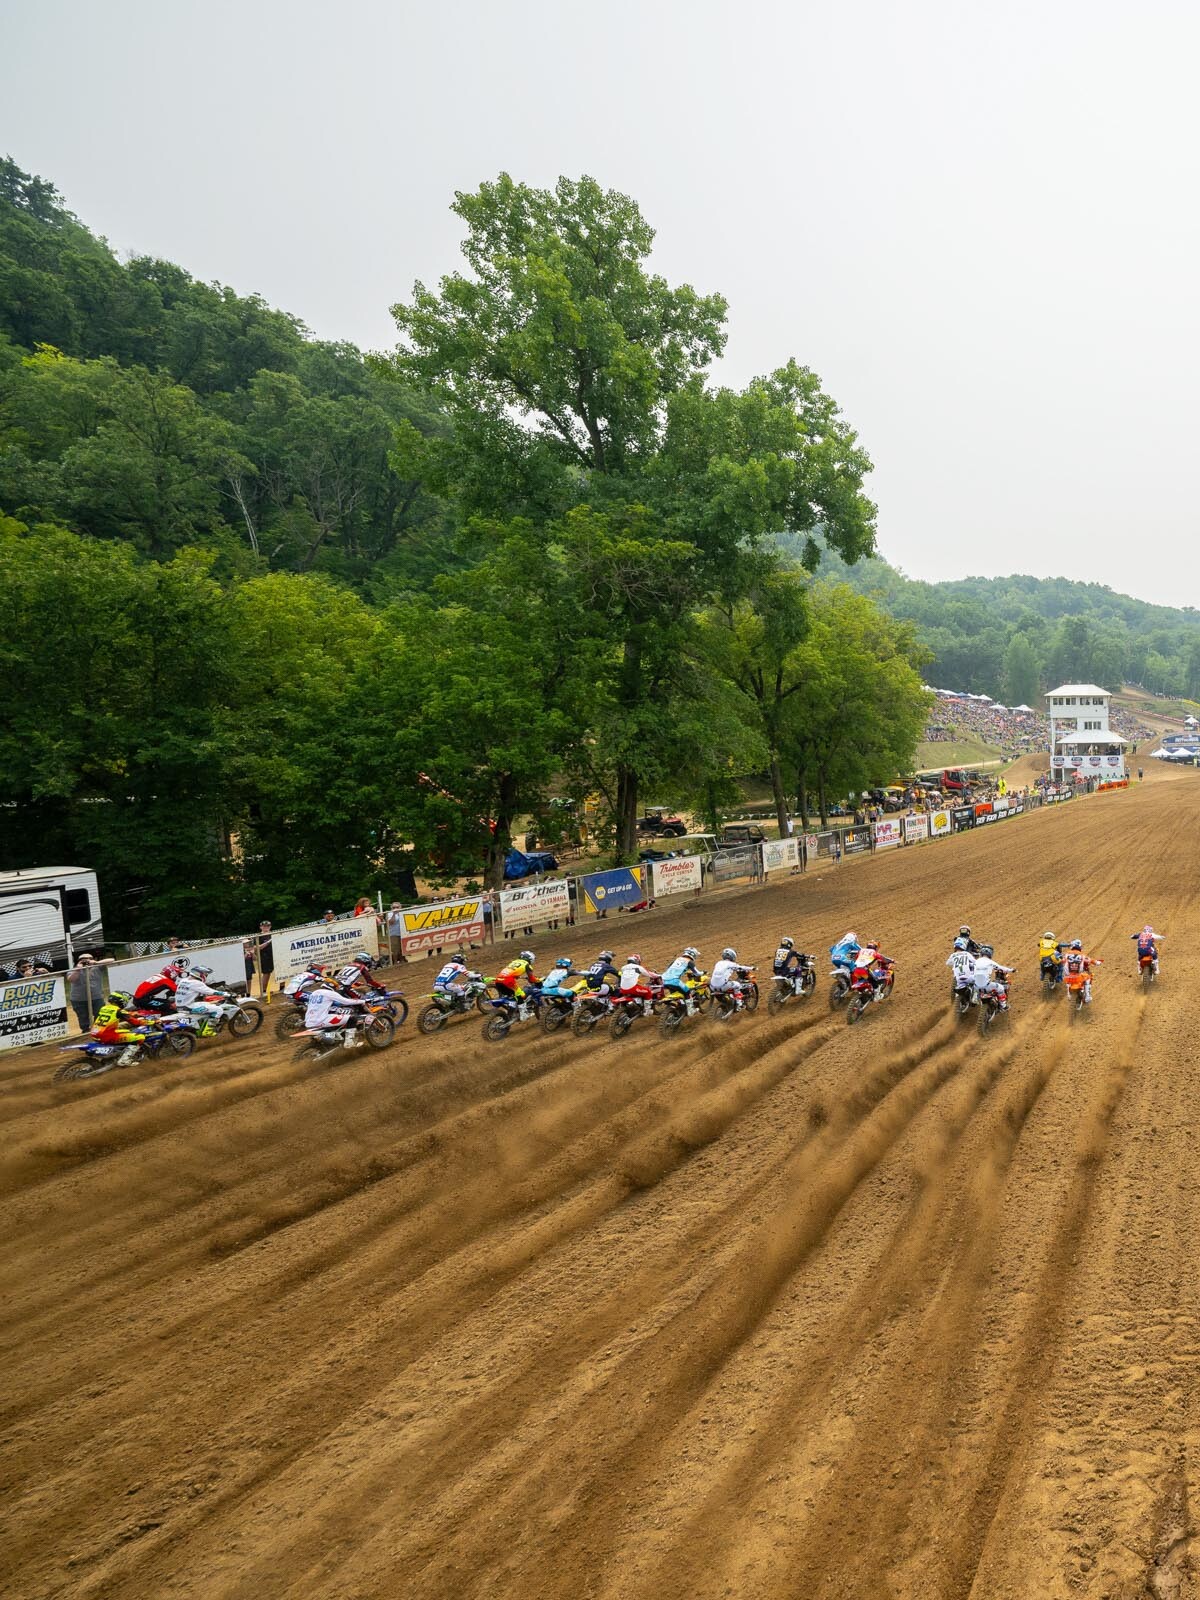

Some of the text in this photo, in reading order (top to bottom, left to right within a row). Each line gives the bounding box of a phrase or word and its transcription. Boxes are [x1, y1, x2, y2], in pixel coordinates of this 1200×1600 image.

[403, 902, 480, 932] VAITH
[290, 934, 337, 951] AMERICAN
[337, 929, 363, 941] HOME
[405, 925, 482, 951] GASGAS
[4, 980, 56, 1001] BUNE
[0, 993, 54, 1012] RPRISES
[16, 1017, 60, 1031] Valve Jobs
